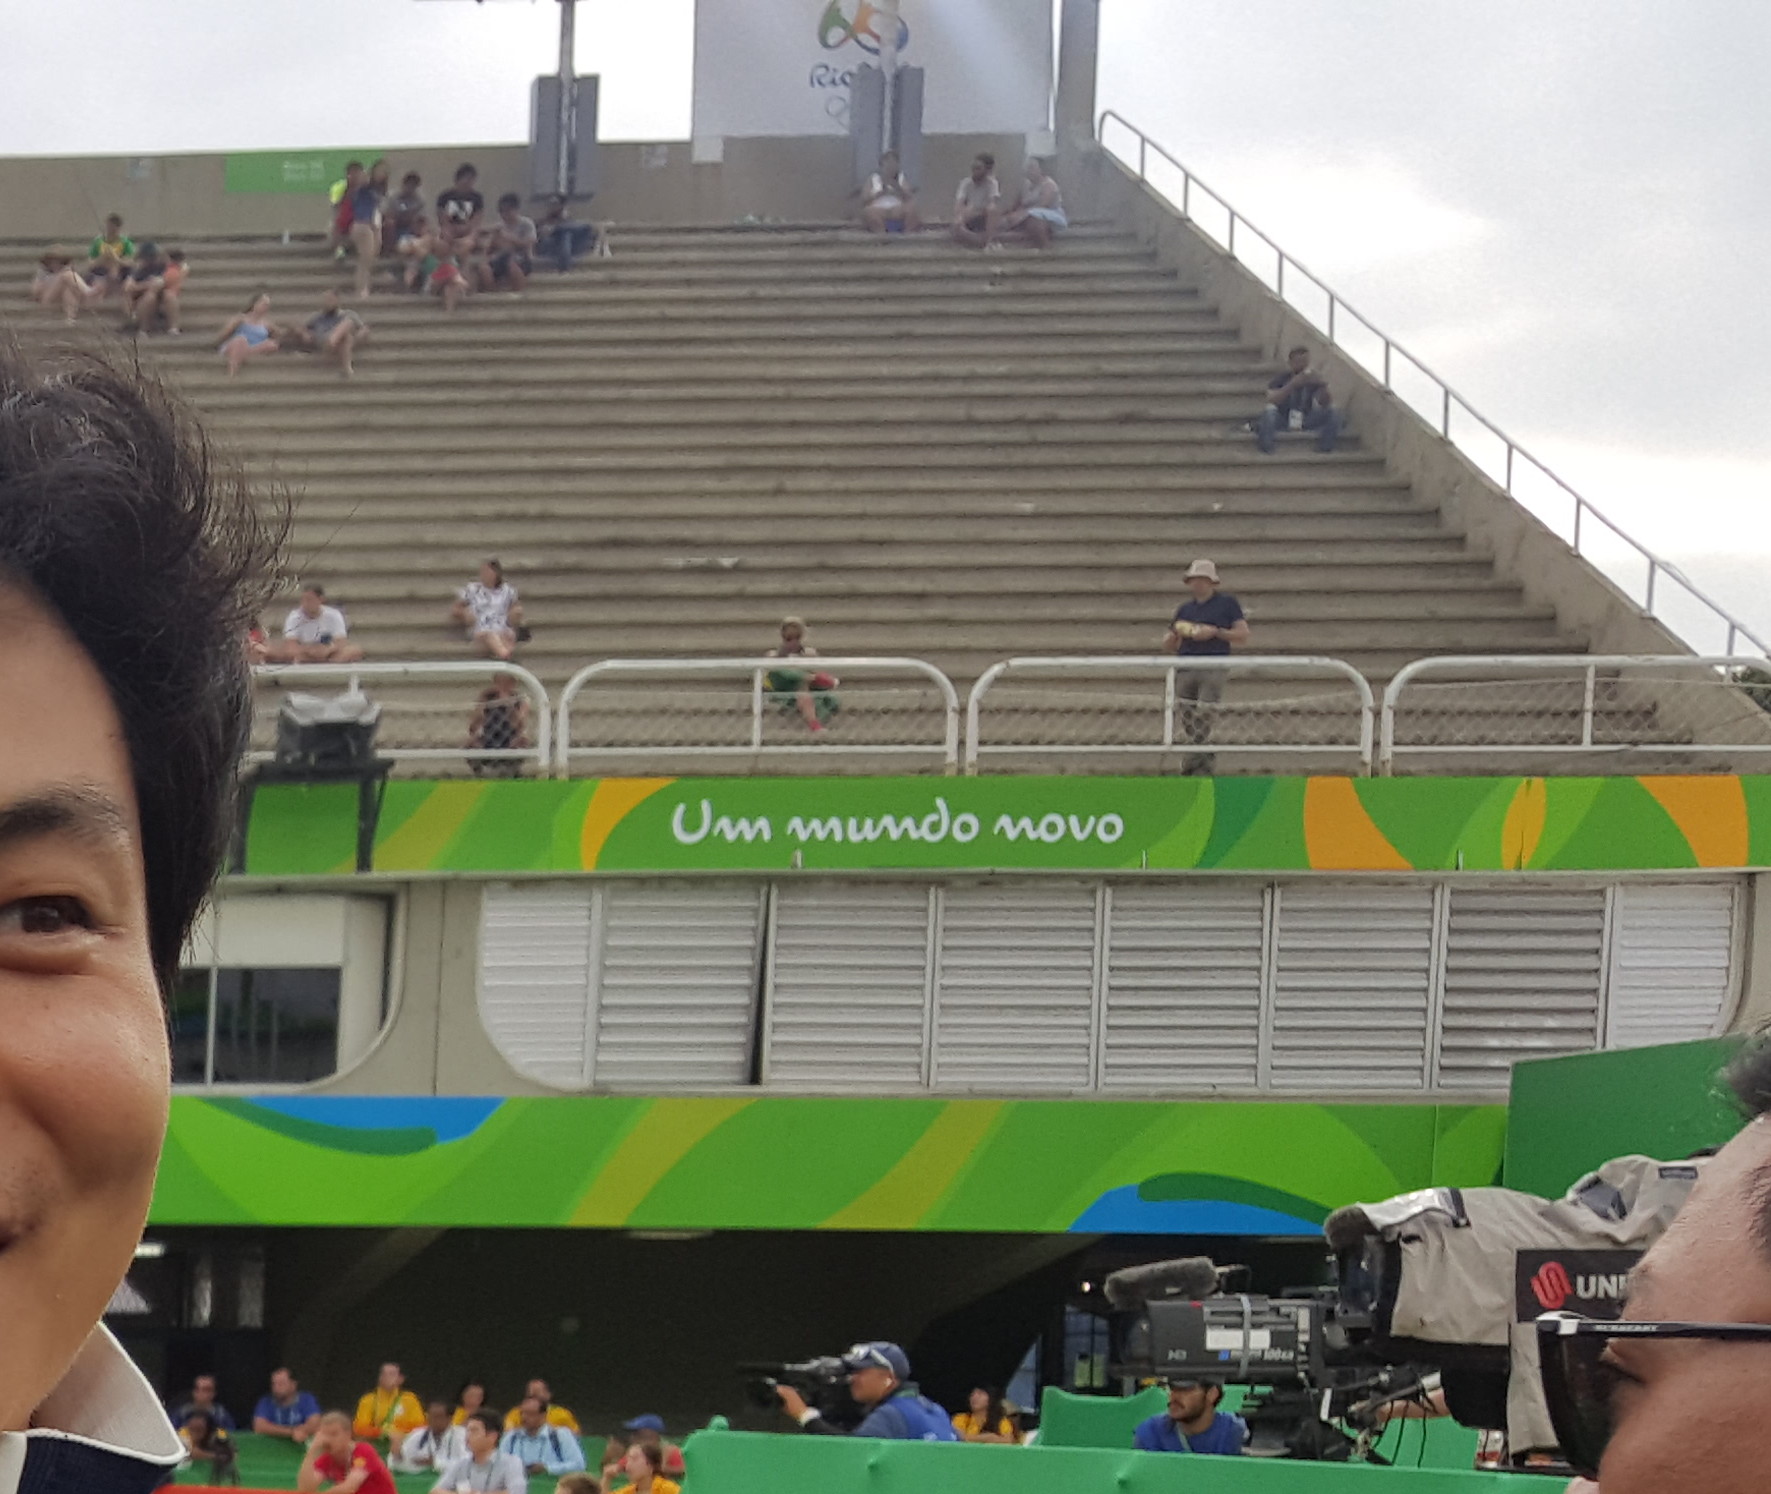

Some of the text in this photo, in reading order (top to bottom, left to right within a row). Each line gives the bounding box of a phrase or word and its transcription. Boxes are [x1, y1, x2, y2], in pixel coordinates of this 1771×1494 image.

[672, 798, 1125, 844] Um mundo novo
